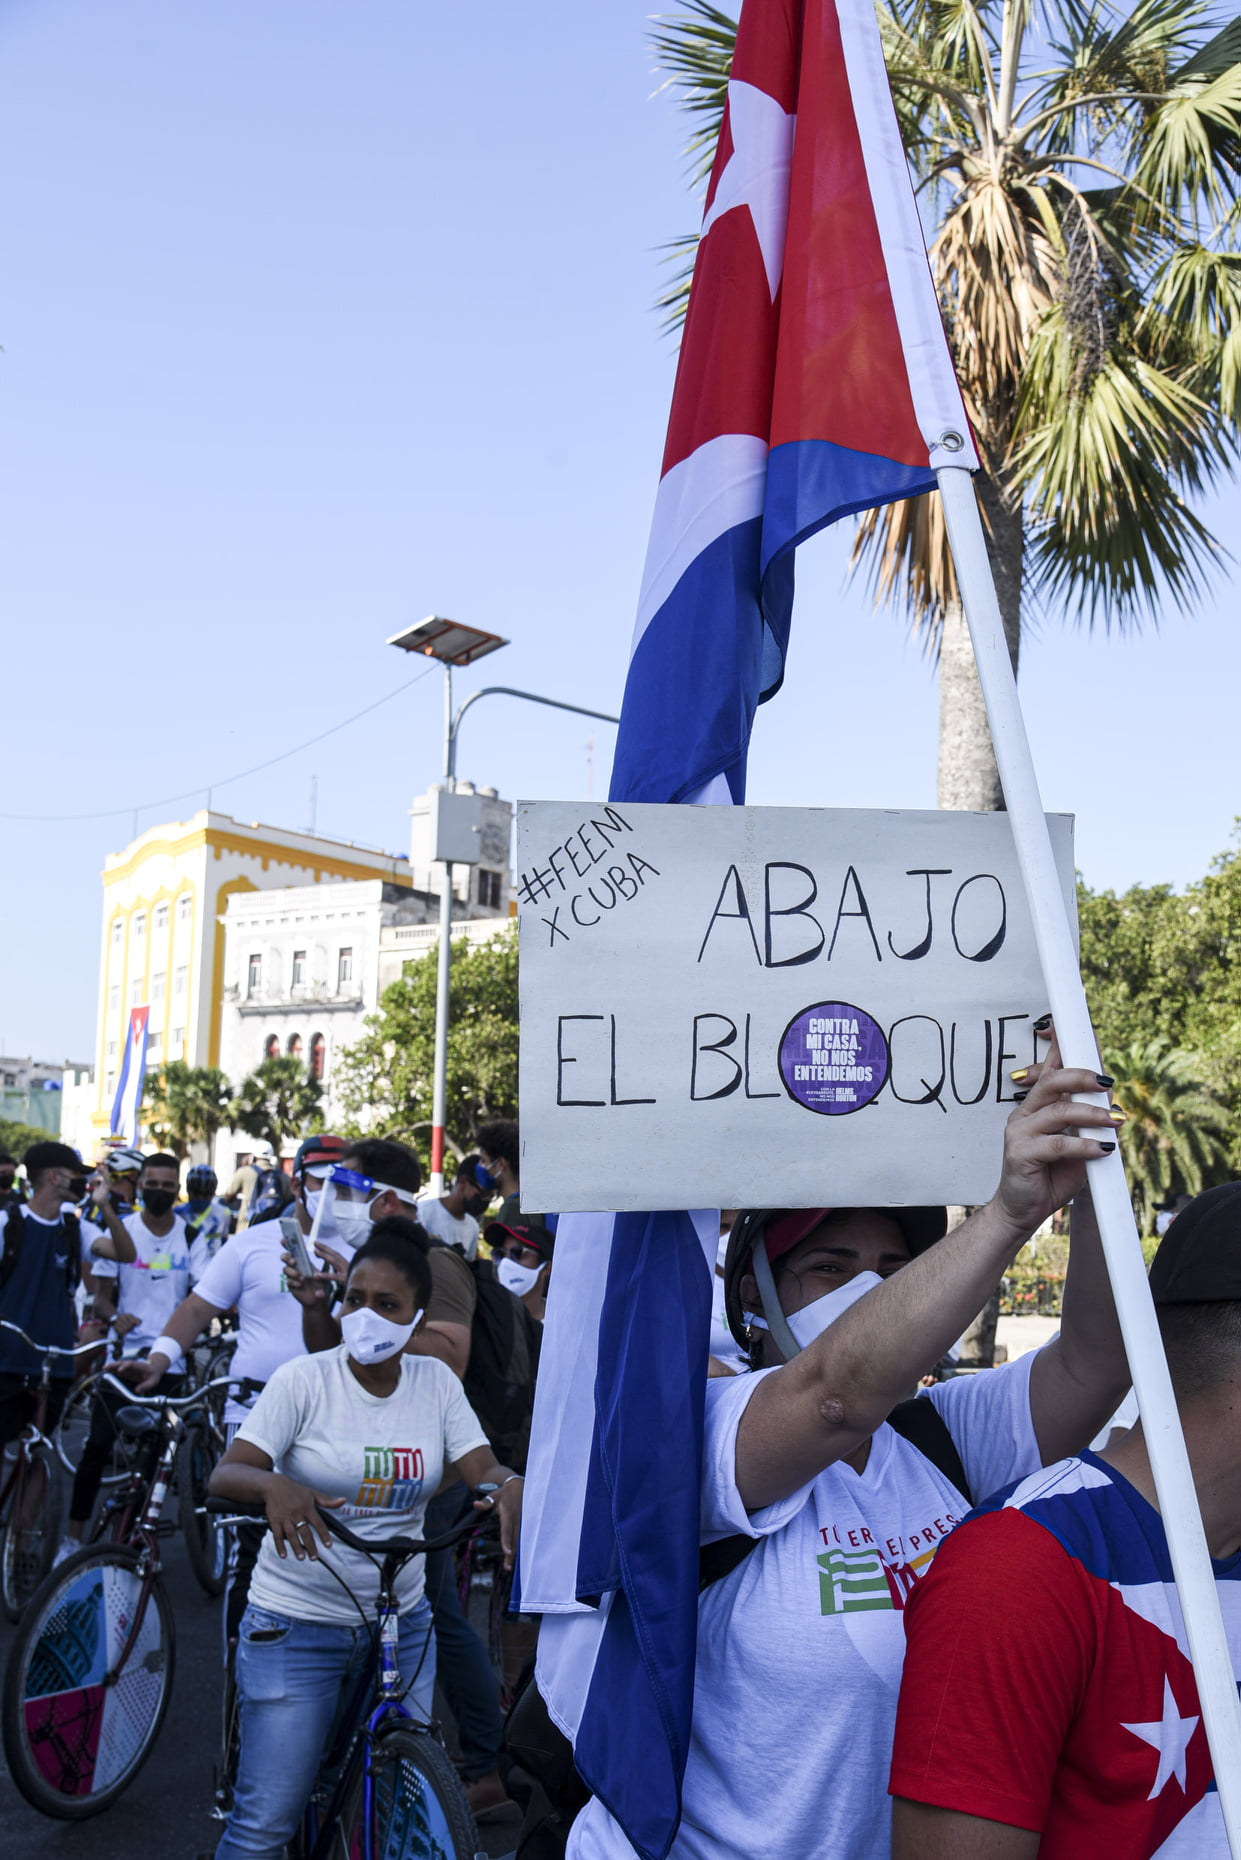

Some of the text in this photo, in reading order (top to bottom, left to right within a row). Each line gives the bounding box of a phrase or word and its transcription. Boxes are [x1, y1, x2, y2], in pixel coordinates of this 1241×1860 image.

[517, 806, 634, 905] #FEEM
[697, 861, 1007, 968] ABAJO
[809, 1018, 859, 1034] CONTRA
[806, 1034, 862, 1051] MI CASA,
[556, 1000, 1053, 1116] EL BLOQUE
[812, 1050, 856, 1066] NO NOS
[794, 1065, 873, 1082] ENTENDEMOS
